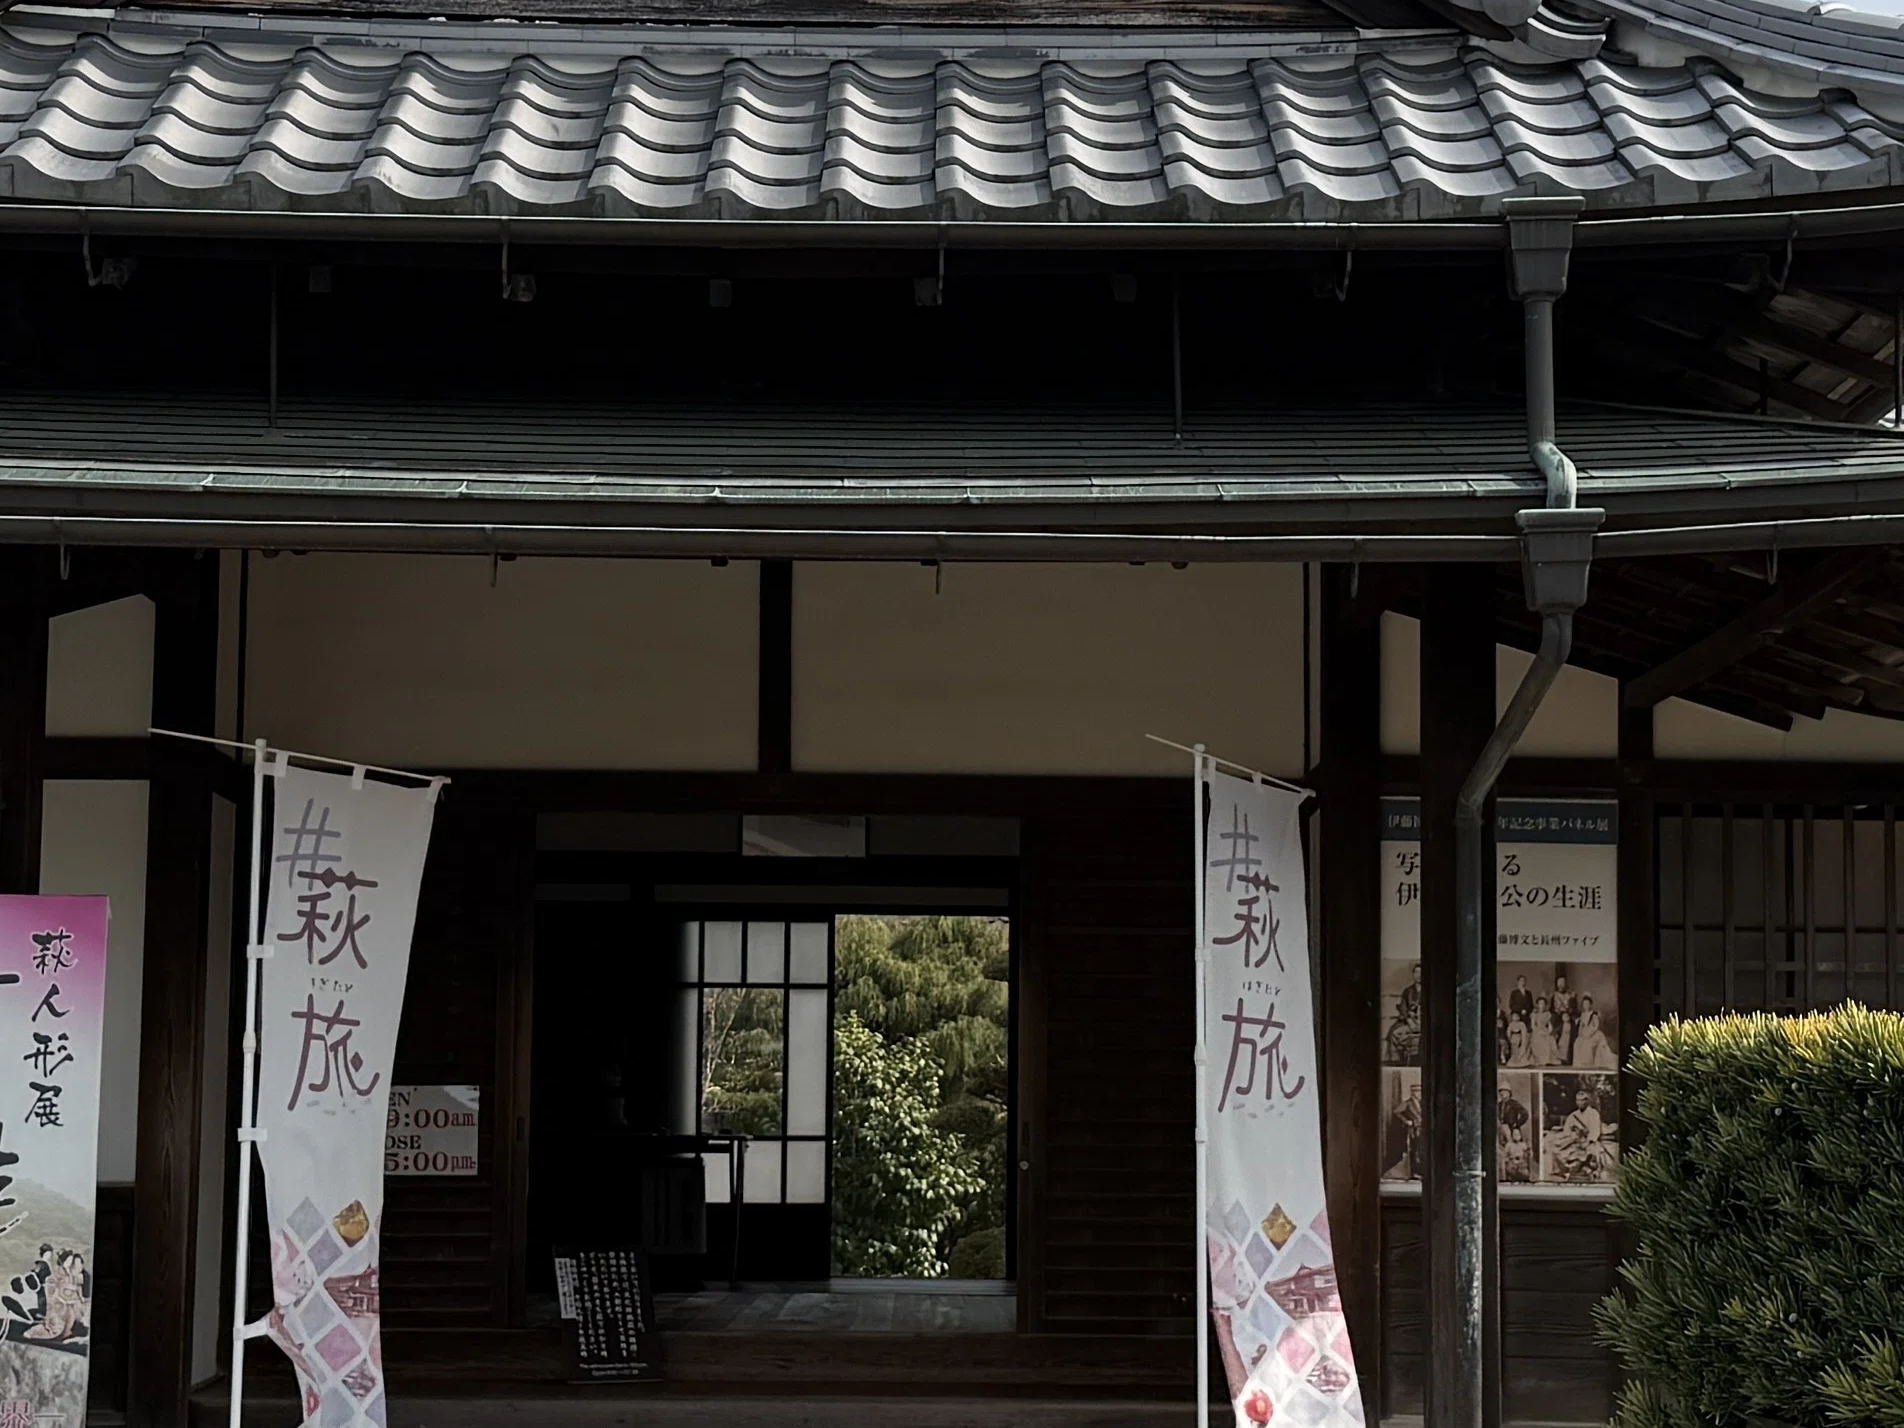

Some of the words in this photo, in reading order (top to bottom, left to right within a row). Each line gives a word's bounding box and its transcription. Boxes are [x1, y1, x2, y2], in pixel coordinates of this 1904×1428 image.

[1500, 884, 1602, 910] 公の生涯
[23, 928, 78, 1128] 萩人形展
[388, 1092, 411, 1107] EN
[385, 1135, 422, 1150] OSE
